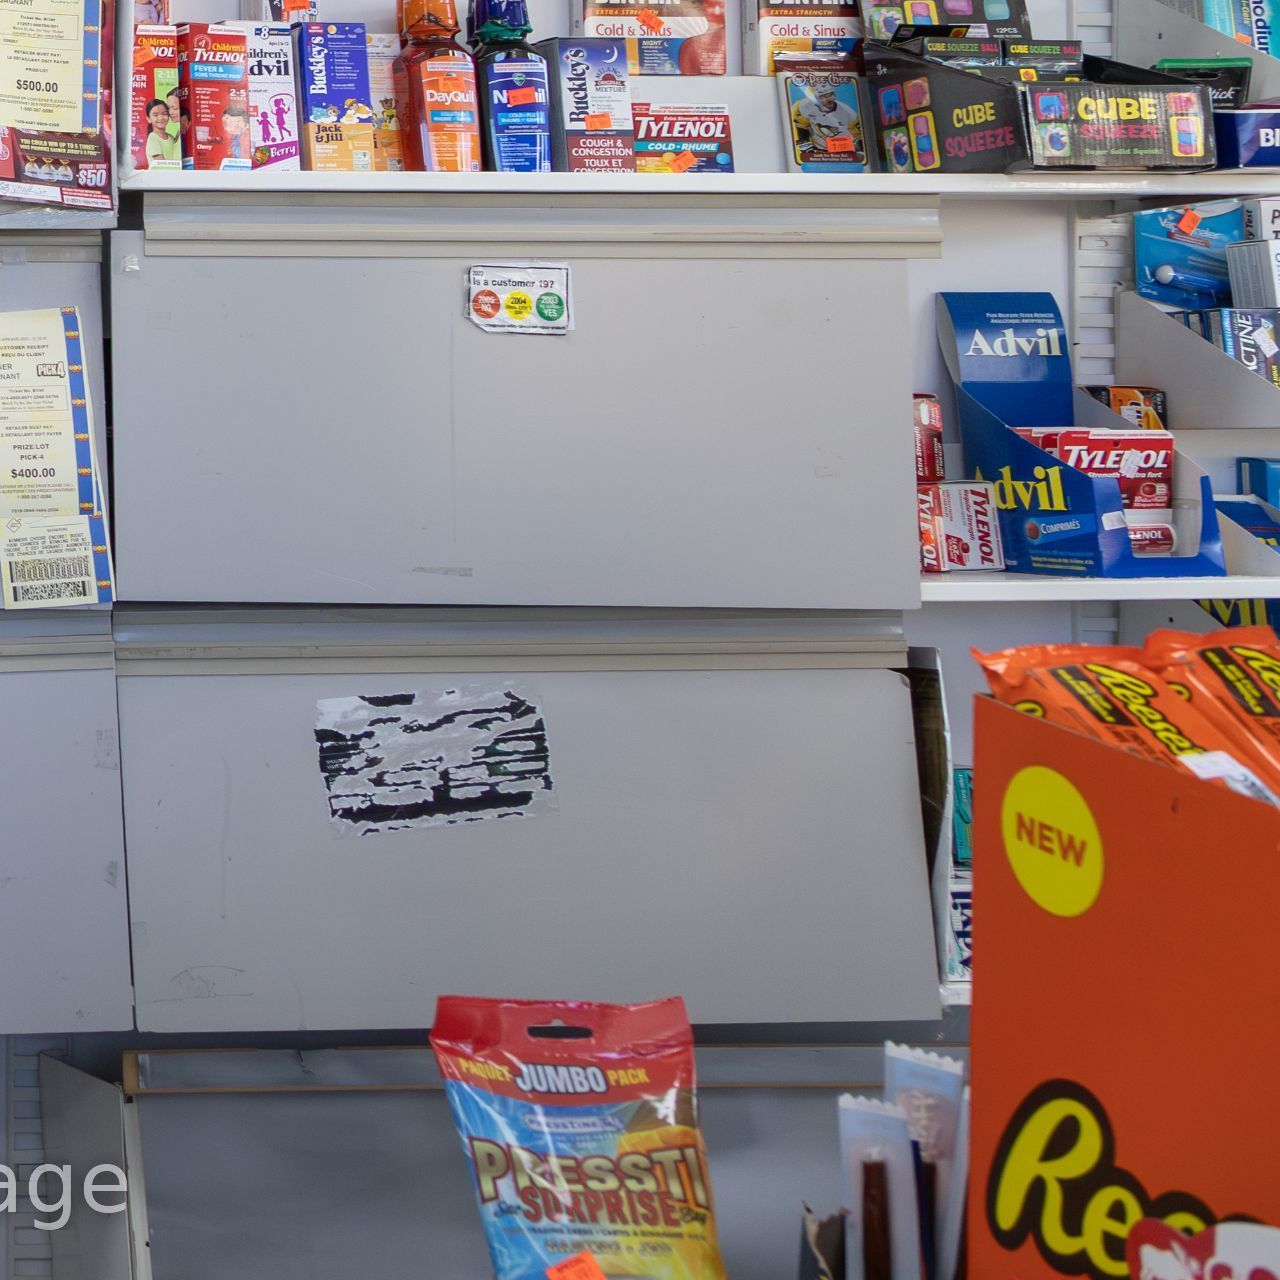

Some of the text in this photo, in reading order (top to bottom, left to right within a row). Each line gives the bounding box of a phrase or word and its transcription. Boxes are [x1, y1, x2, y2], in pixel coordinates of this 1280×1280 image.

[770, 24, 846, 37] Cold & Sinus
[1010, 45, 1029, 54] CUBE
[1030, 45, 1061, 54] SQUEEZE
[309, 36, 327, 95] Buckley's
[426, 88, 475, 103] DayQuil
[315, 125, 342, 133] Jack
[635, 116, 726, 138] TYLENOL
[325, 132, 343, 142] Jill
[580, 139, 623, 148] COUGH &
[944, 126, 1016, 157] SQUEEZE
[270, 145, 296, 158] Berry
[572, 147, 633, 157] CONGESTION
[682, 142, 718, 151] RHUME
[583, 158, 622, 167] TOUX ET
[965, 328, 1063, 357] Advil
[1016, 812, 1087, 868] NEW
[516, 1064, 607, 1093] JUMBO
[608, 1068, 649, 1087] PACK
[468, 1137, 710, 1209] PRESSTI
[520, 1186, 681, 1227] SURPRISE
